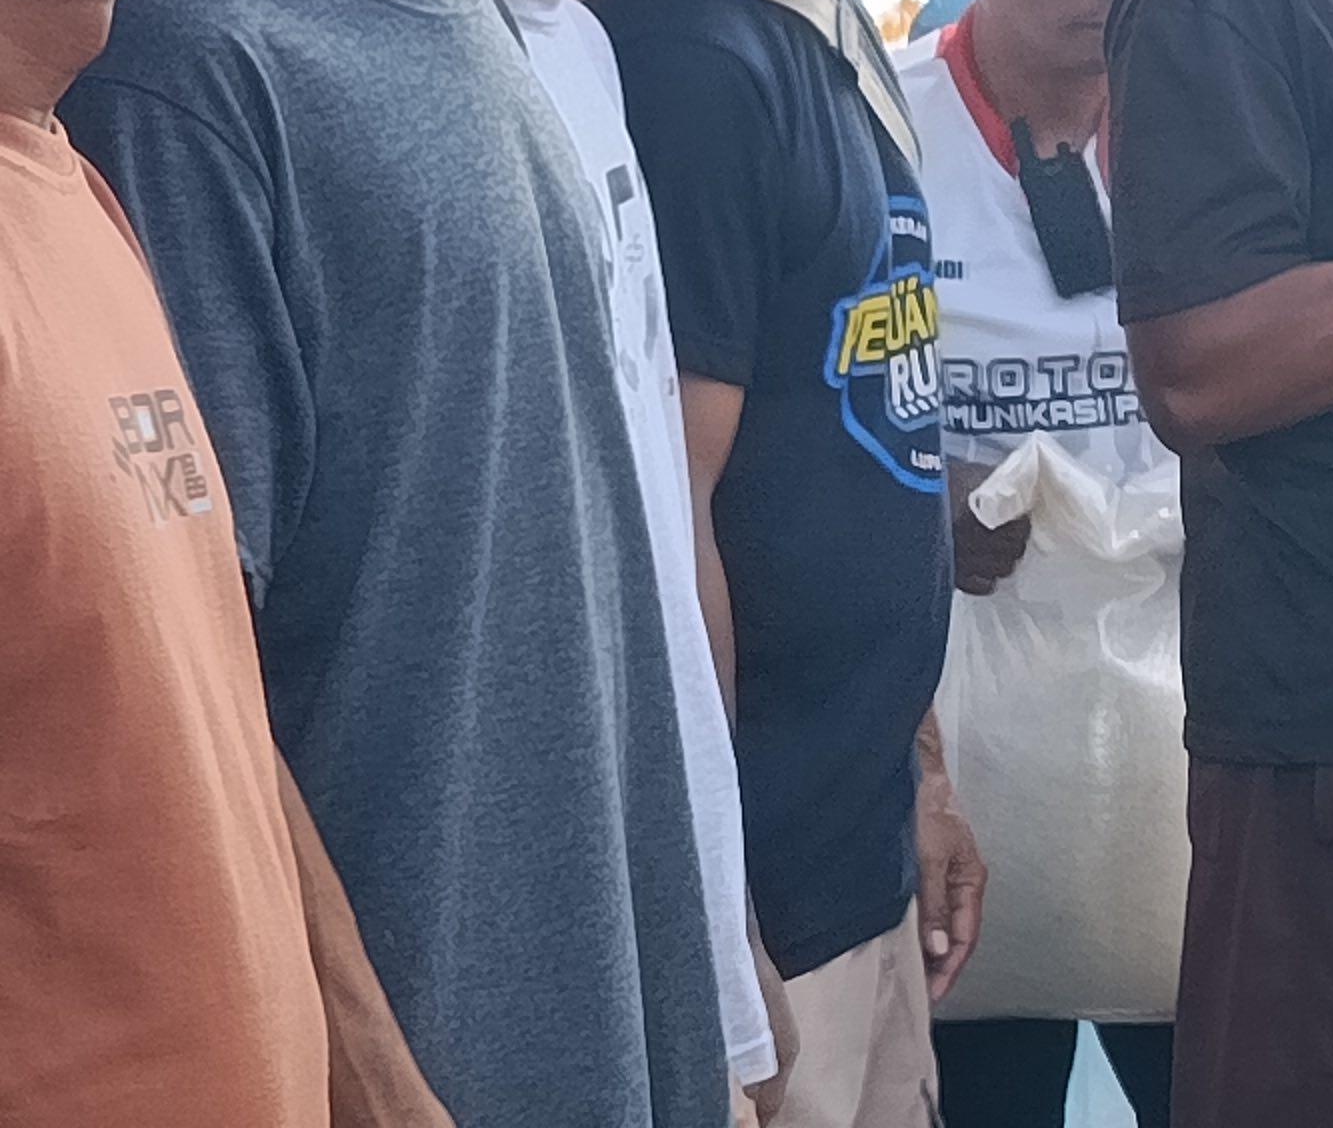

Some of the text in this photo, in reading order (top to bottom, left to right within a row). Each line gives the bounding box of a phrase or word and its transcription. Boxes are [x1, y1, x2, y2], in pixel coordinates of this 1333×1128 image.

[889, 341, 941, 410] RU
[941, 352, 1127, 400] ROTO
[945, 394, 1107, 431] MUNIKASI
